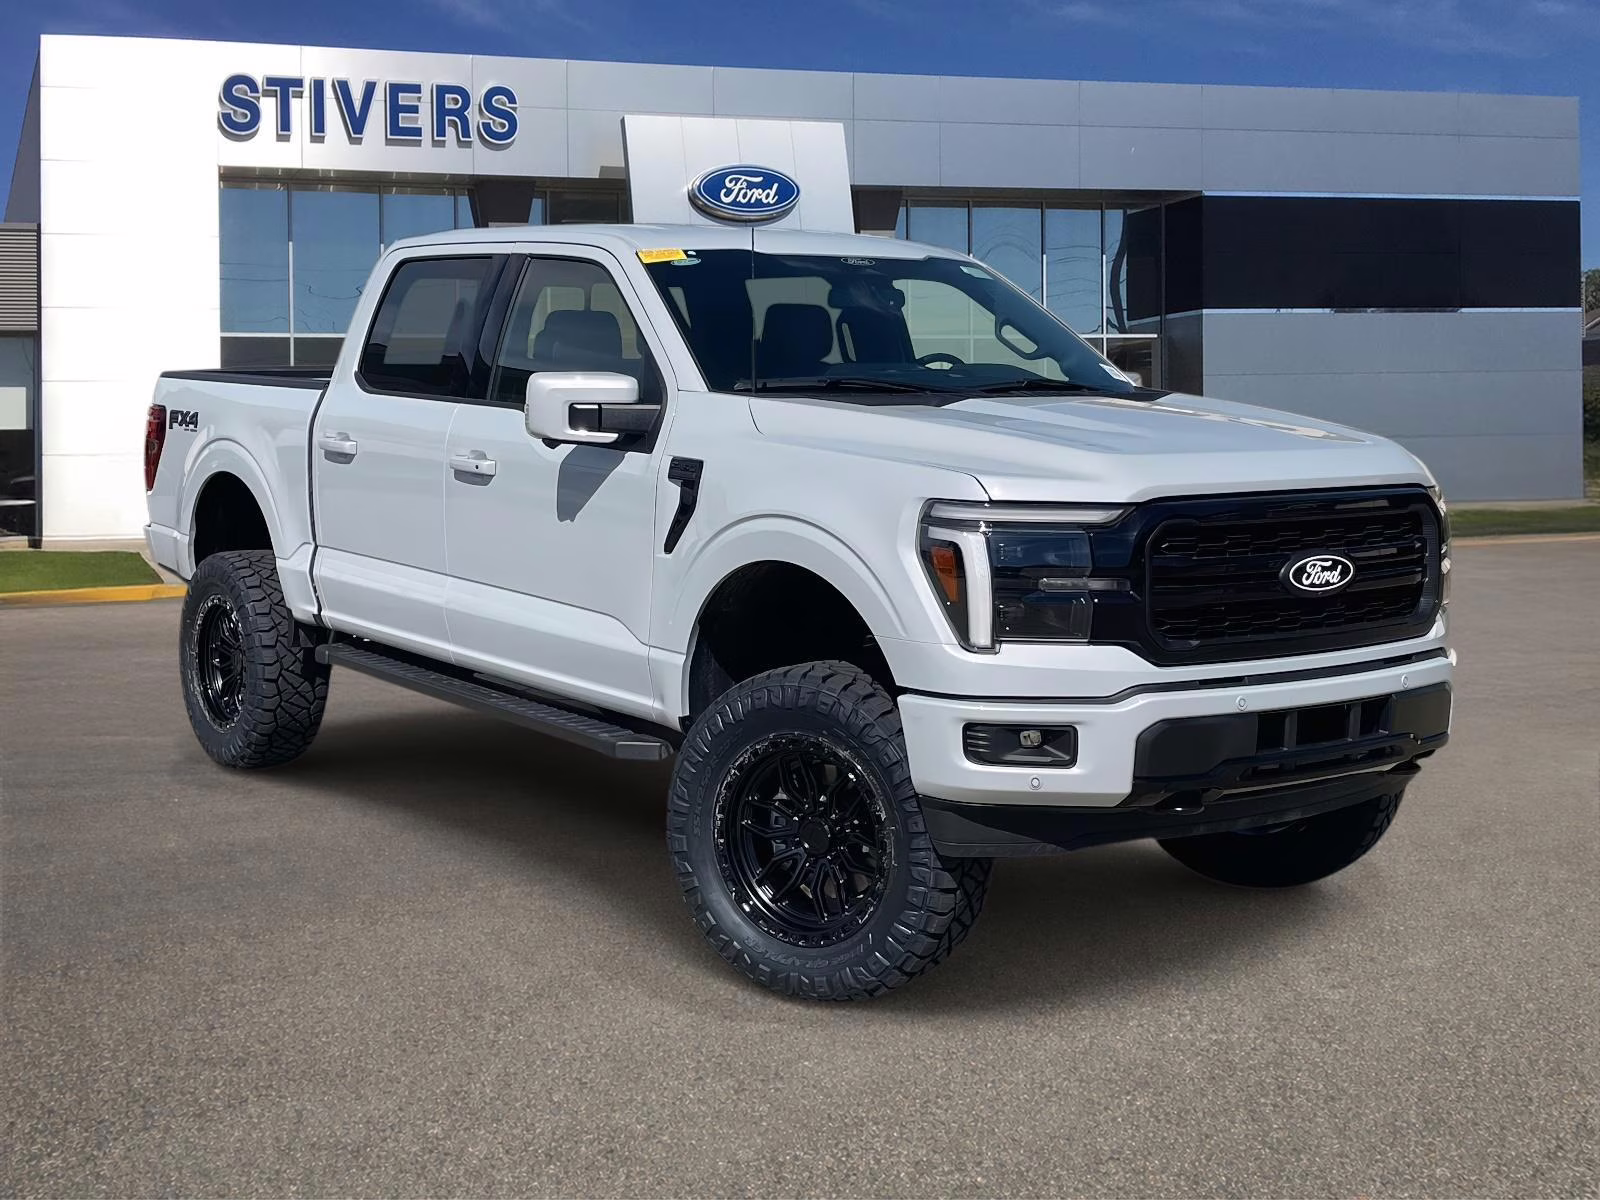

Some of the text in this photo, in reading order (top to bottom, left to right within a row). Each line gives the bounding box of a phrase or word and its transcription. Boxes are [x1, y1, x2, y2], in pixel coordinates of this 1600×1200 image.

[218, 73, 519, 145] STIVERS
[720, 174, 779, 204] Ford
[169, 409, 200, 430] FX4
[1302, 560, 1342, 586] Ford
